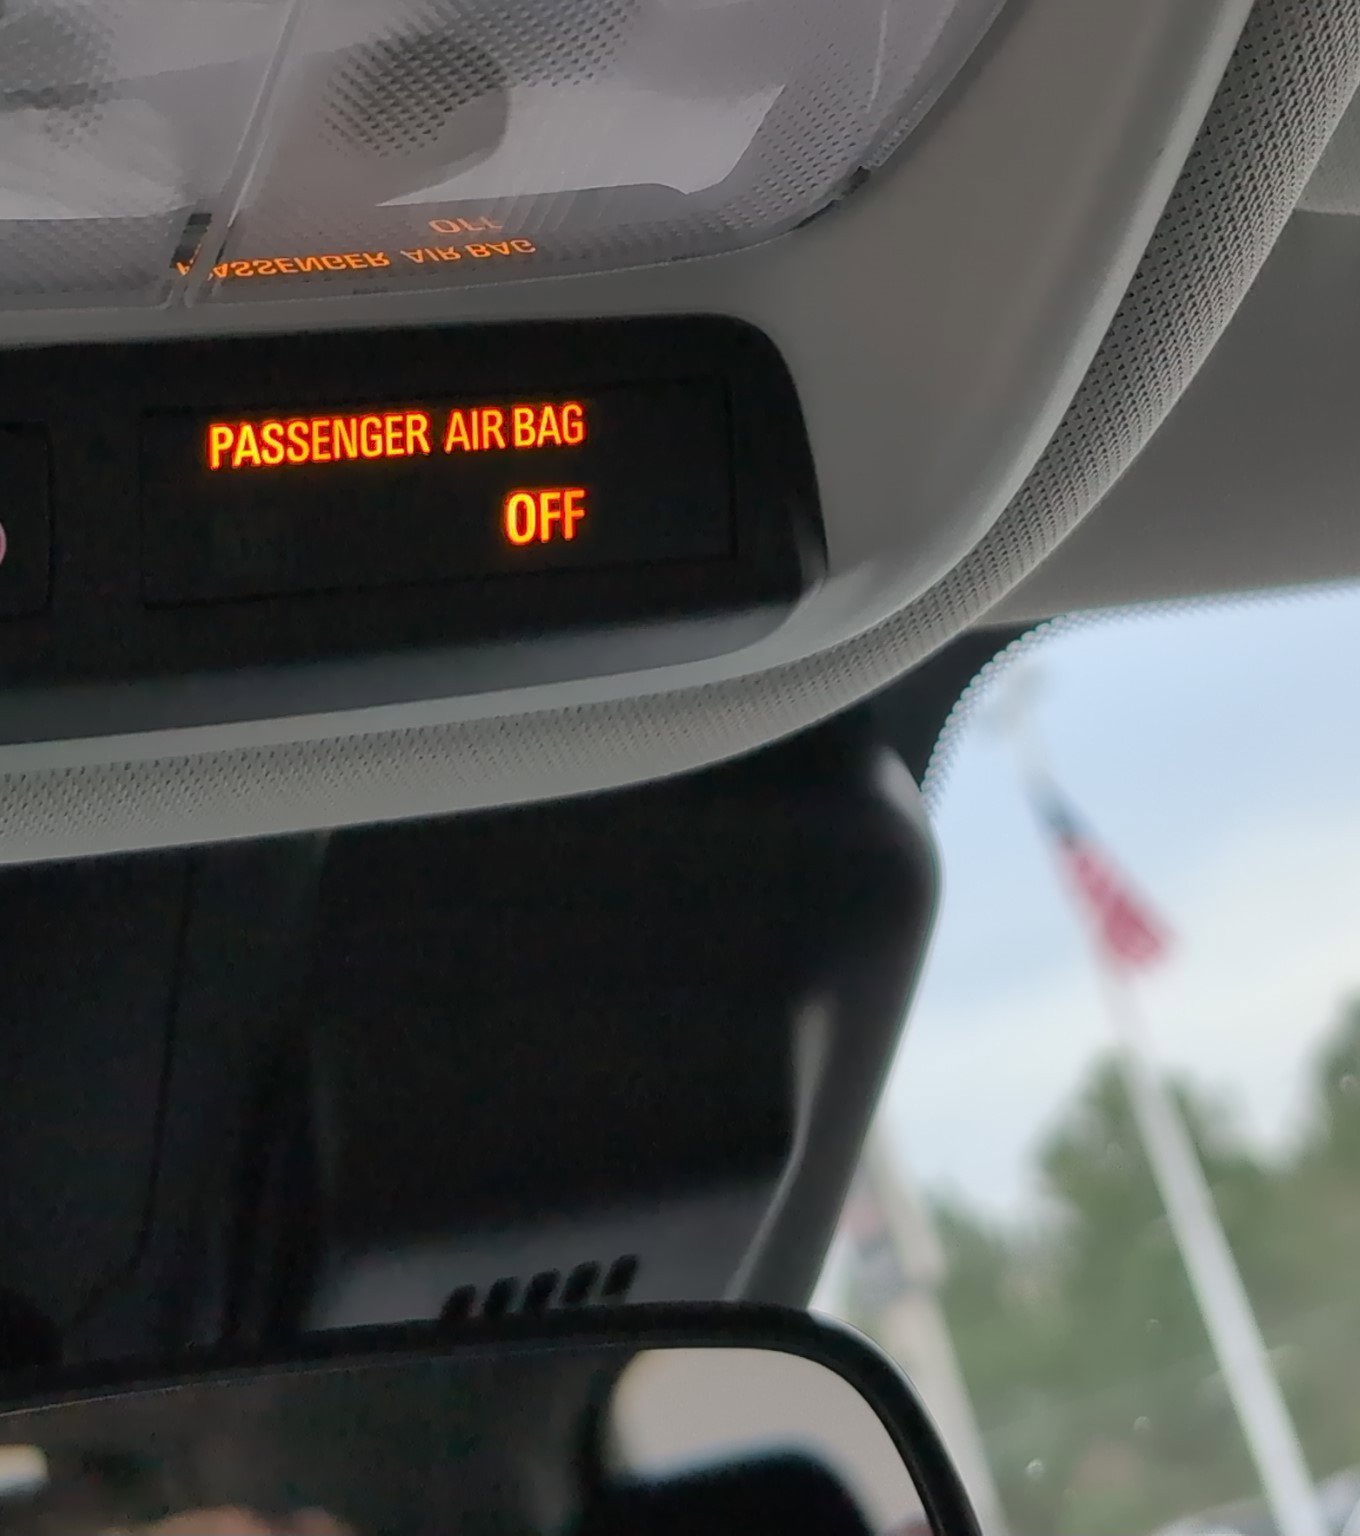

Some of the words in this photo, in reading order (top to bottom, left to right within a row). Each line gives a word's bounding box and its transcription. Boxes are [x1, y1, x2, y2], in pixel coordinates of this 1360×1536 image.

[207, 411, 432, 471] PASSENGER
[443, 404, 507, 455] AIR
[512, 399, 586, 448] BAG
[503, 486, 587, 547] OFF
